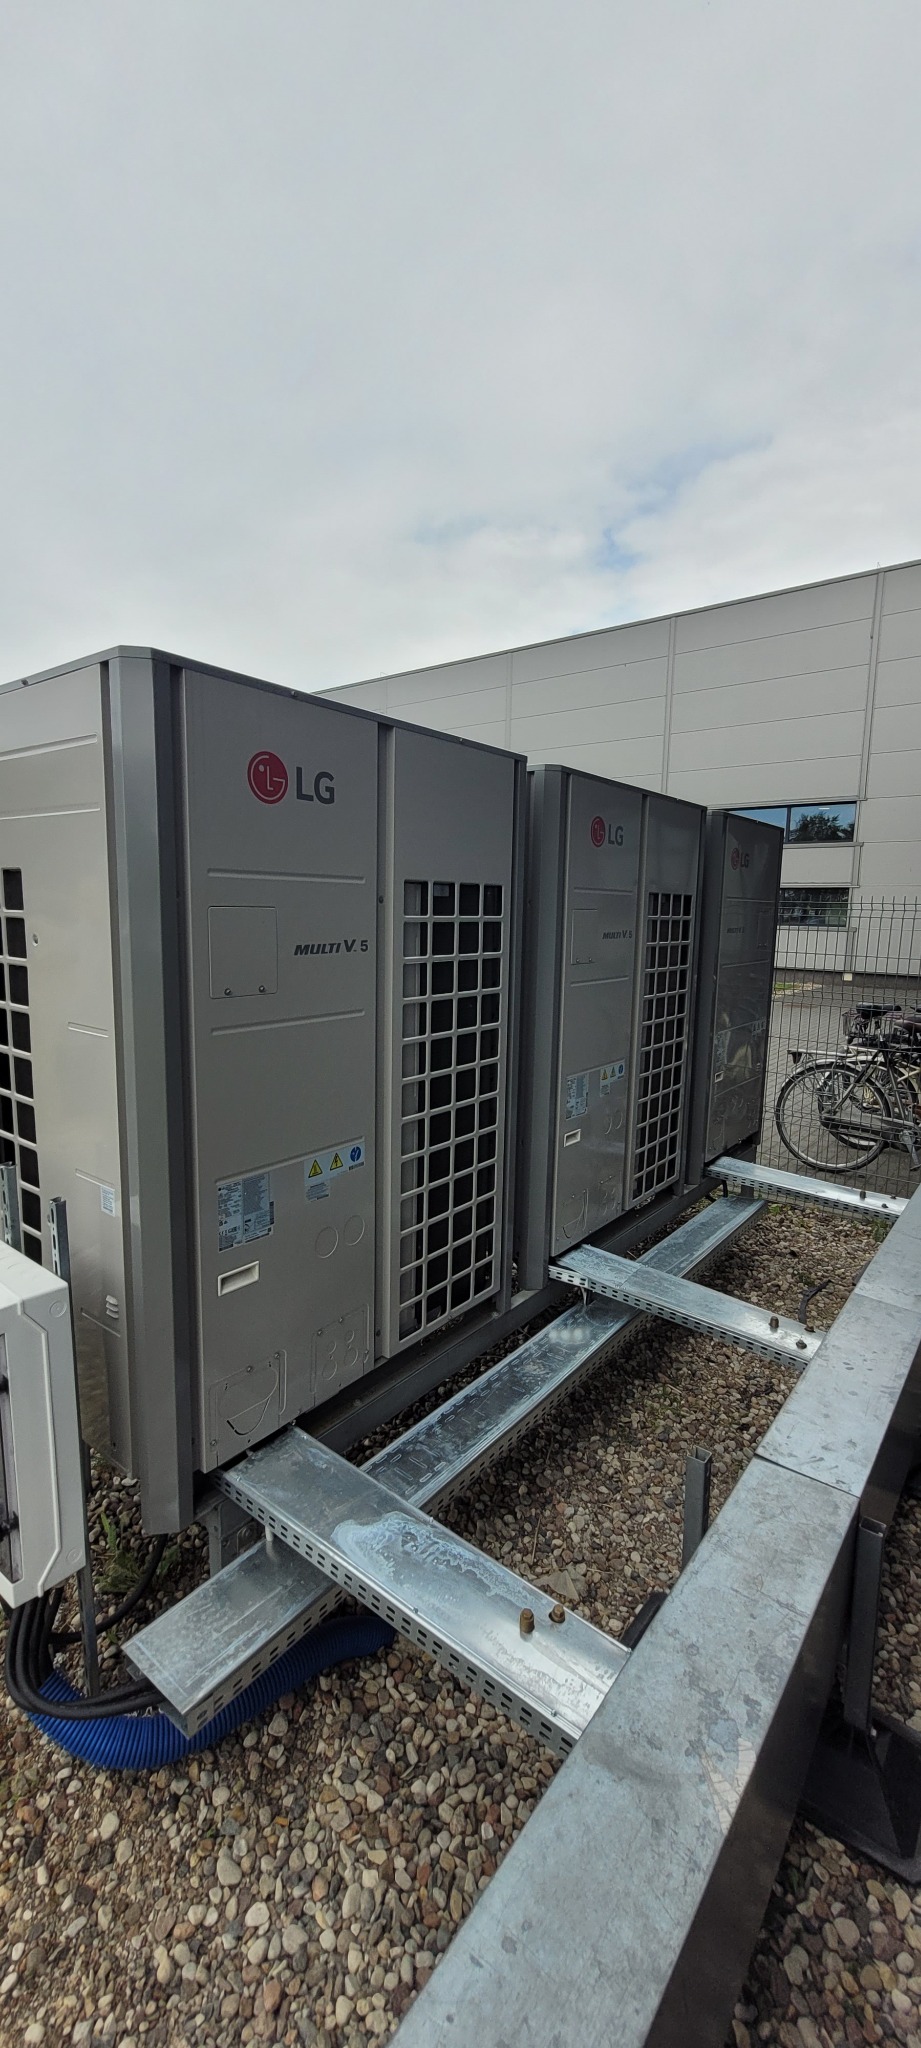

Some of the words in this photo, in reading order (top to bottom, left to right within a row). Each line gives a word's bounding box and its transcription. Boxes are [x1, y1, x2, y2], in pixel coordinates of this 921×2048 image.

[296, 766, 335, 805] LG
[608, 823, 624, 846] LG
[740, 851, 750, 868] LG
[294, 942, 342, 956] MULTI
[360, 939, 369, 953] 5
